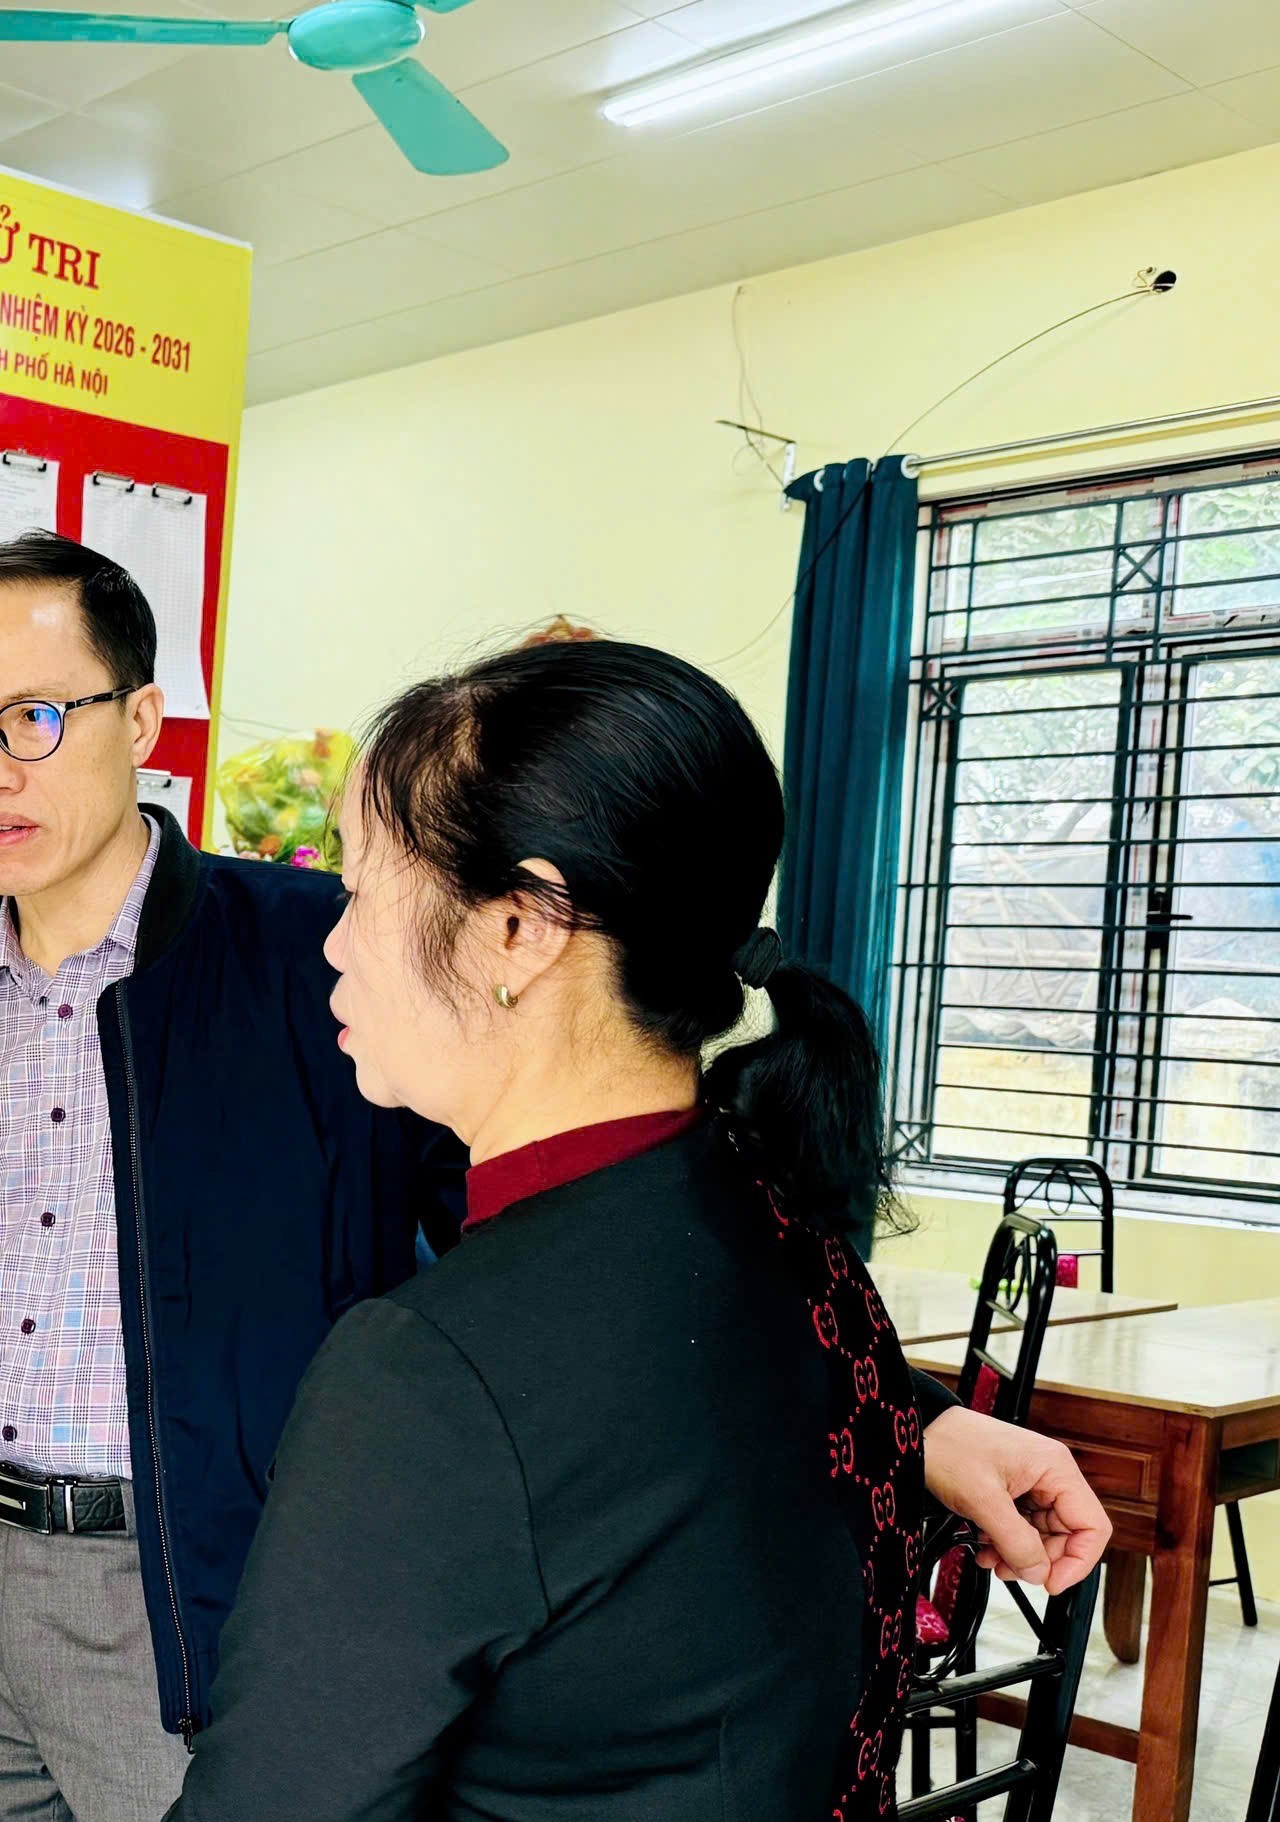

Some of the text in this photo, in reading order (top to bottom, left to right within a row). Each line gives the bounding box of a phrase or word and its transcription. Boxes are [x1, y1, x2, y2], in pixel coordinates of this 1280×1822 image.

[28, 232, 101, 290] TRI
[0, 293, 59, 342] NHIỆM
[65, 305, 90, 345] KỲ
[93, 318, 136, 358] 2026
[151, 333, 191, 373] 2031
[13, 352, 49, 381] PHỐ
[53, 361, 76, 388] HÀ
[80, 368, 109, 397] NỘI
